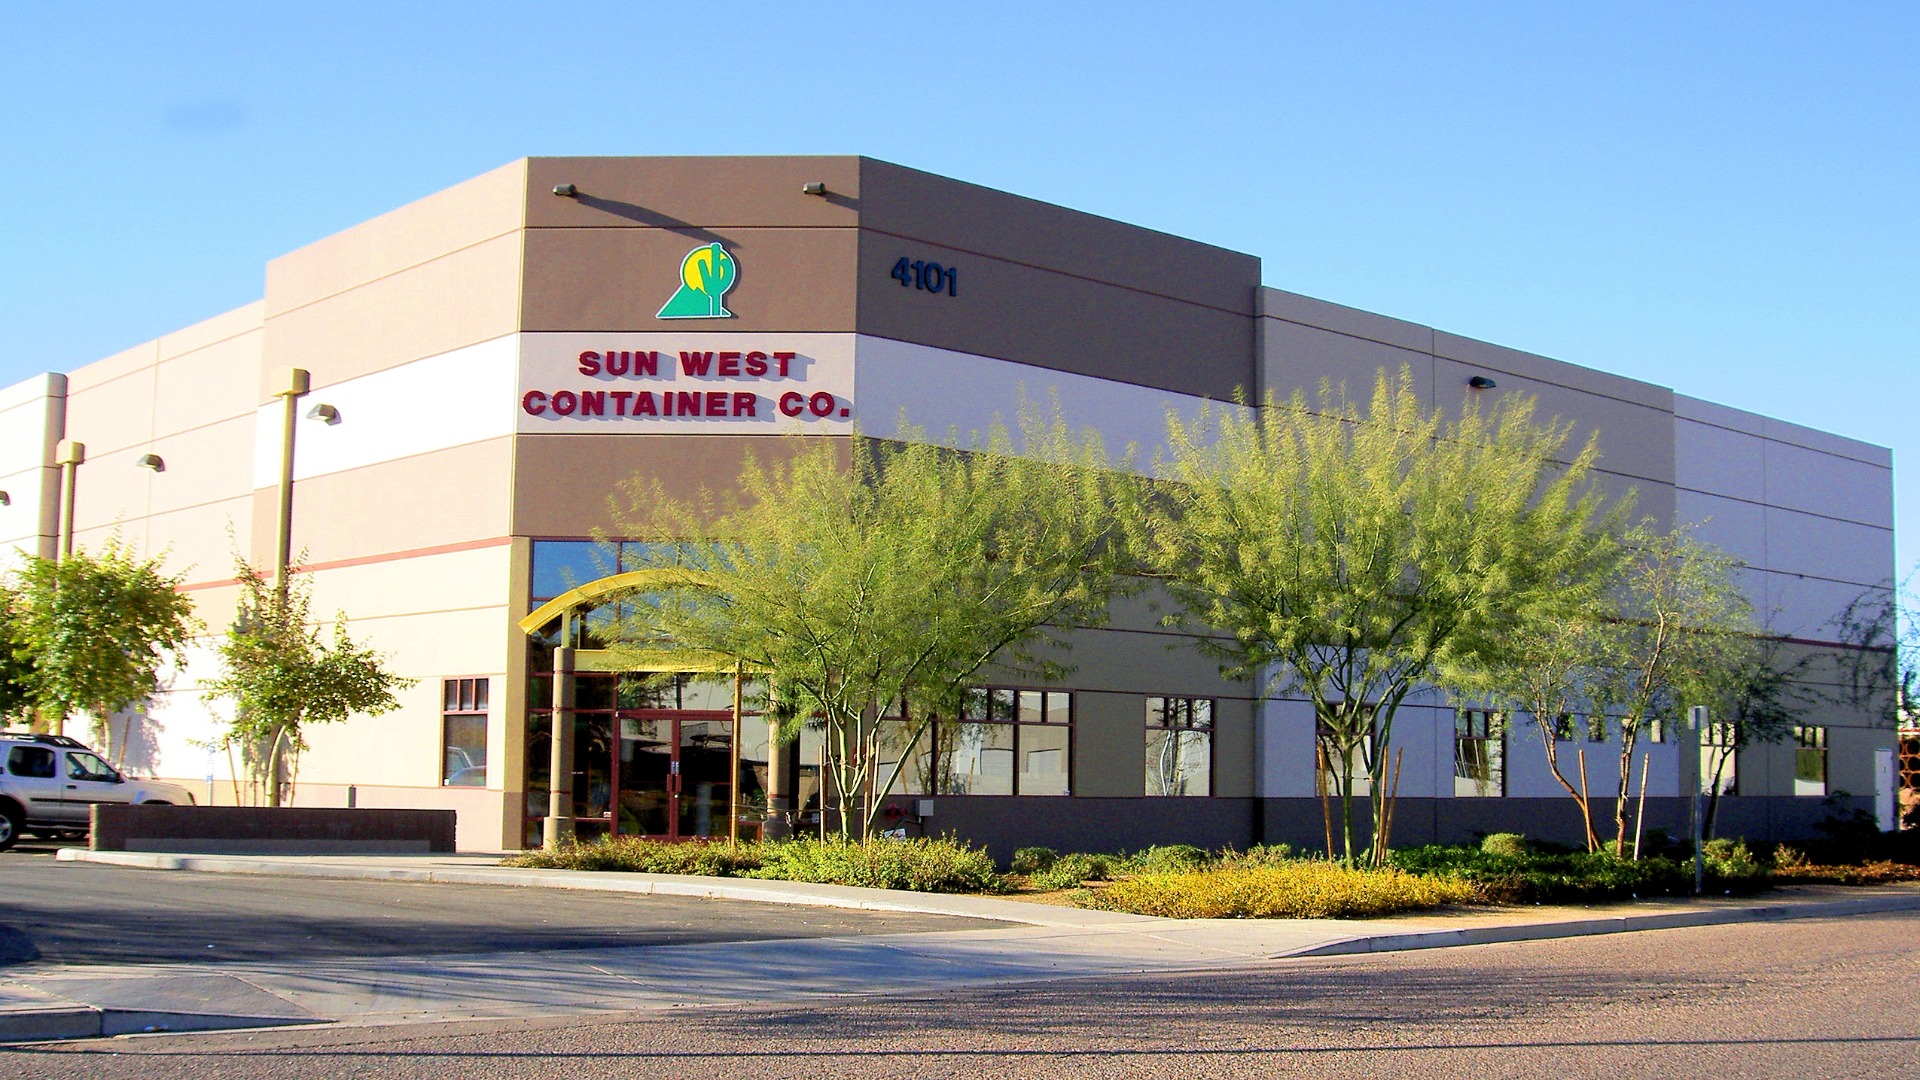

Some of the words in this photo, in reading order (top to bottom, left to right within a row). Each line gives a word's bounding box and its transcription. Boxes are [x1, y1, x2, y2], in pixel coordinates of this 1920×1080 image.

[891, 256, 957, 297] 4101
[578, 350, 658, 377] SUN
[679, 350, 796, 377] WEST
[522, 390, 757, 417] CONTAINER
[779, 390, 850, 418] CO.
